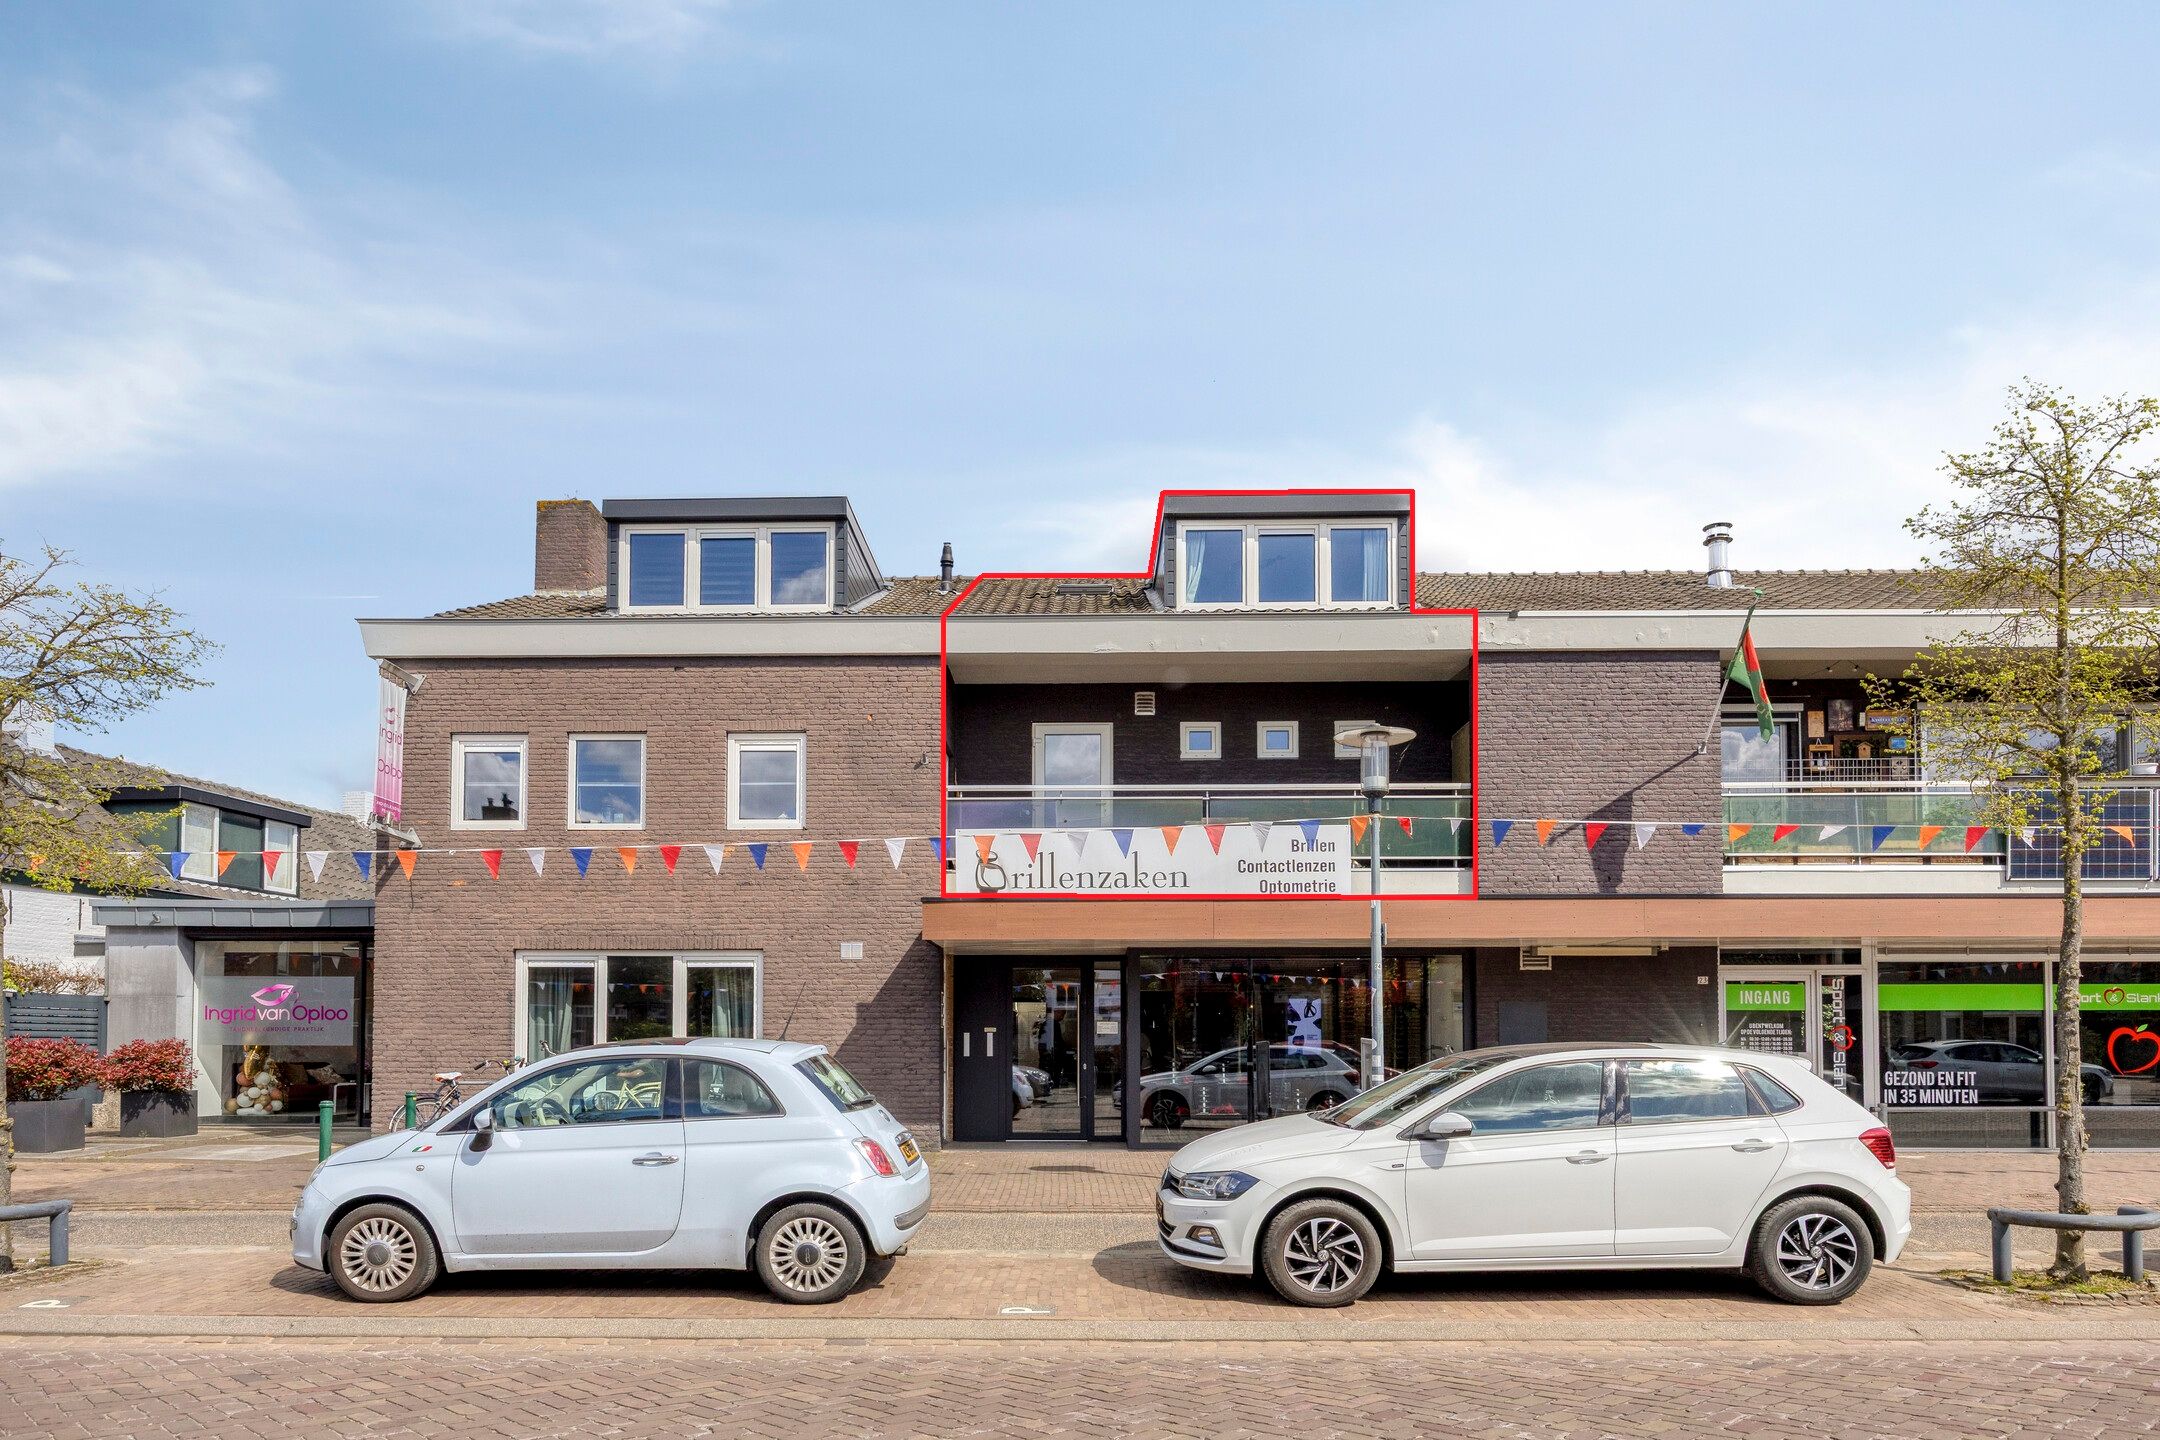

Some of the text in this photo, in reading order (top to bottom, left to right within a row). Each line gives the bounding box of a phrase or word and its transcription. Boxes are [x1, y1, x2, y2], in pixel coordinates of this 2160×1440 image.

[379, 723, 403, 746] Ingrid
[1237, 860, 1336, 873] Contactlenzen
[1259, 880, 1336, 894] Optometrie
[1740, 991, 1791, 1005] INGANG
[1832, 978, 1845, 1023] Sport
[2080, 993, 2102, 1003] ort
[204, 1005, 348, 1024] Ingrid van Oploo
[1884, 1071, 1977, 1086] GEZOND EN FIT
[1883, 1089, 1979, 1104] IN 35 MINUTEN
